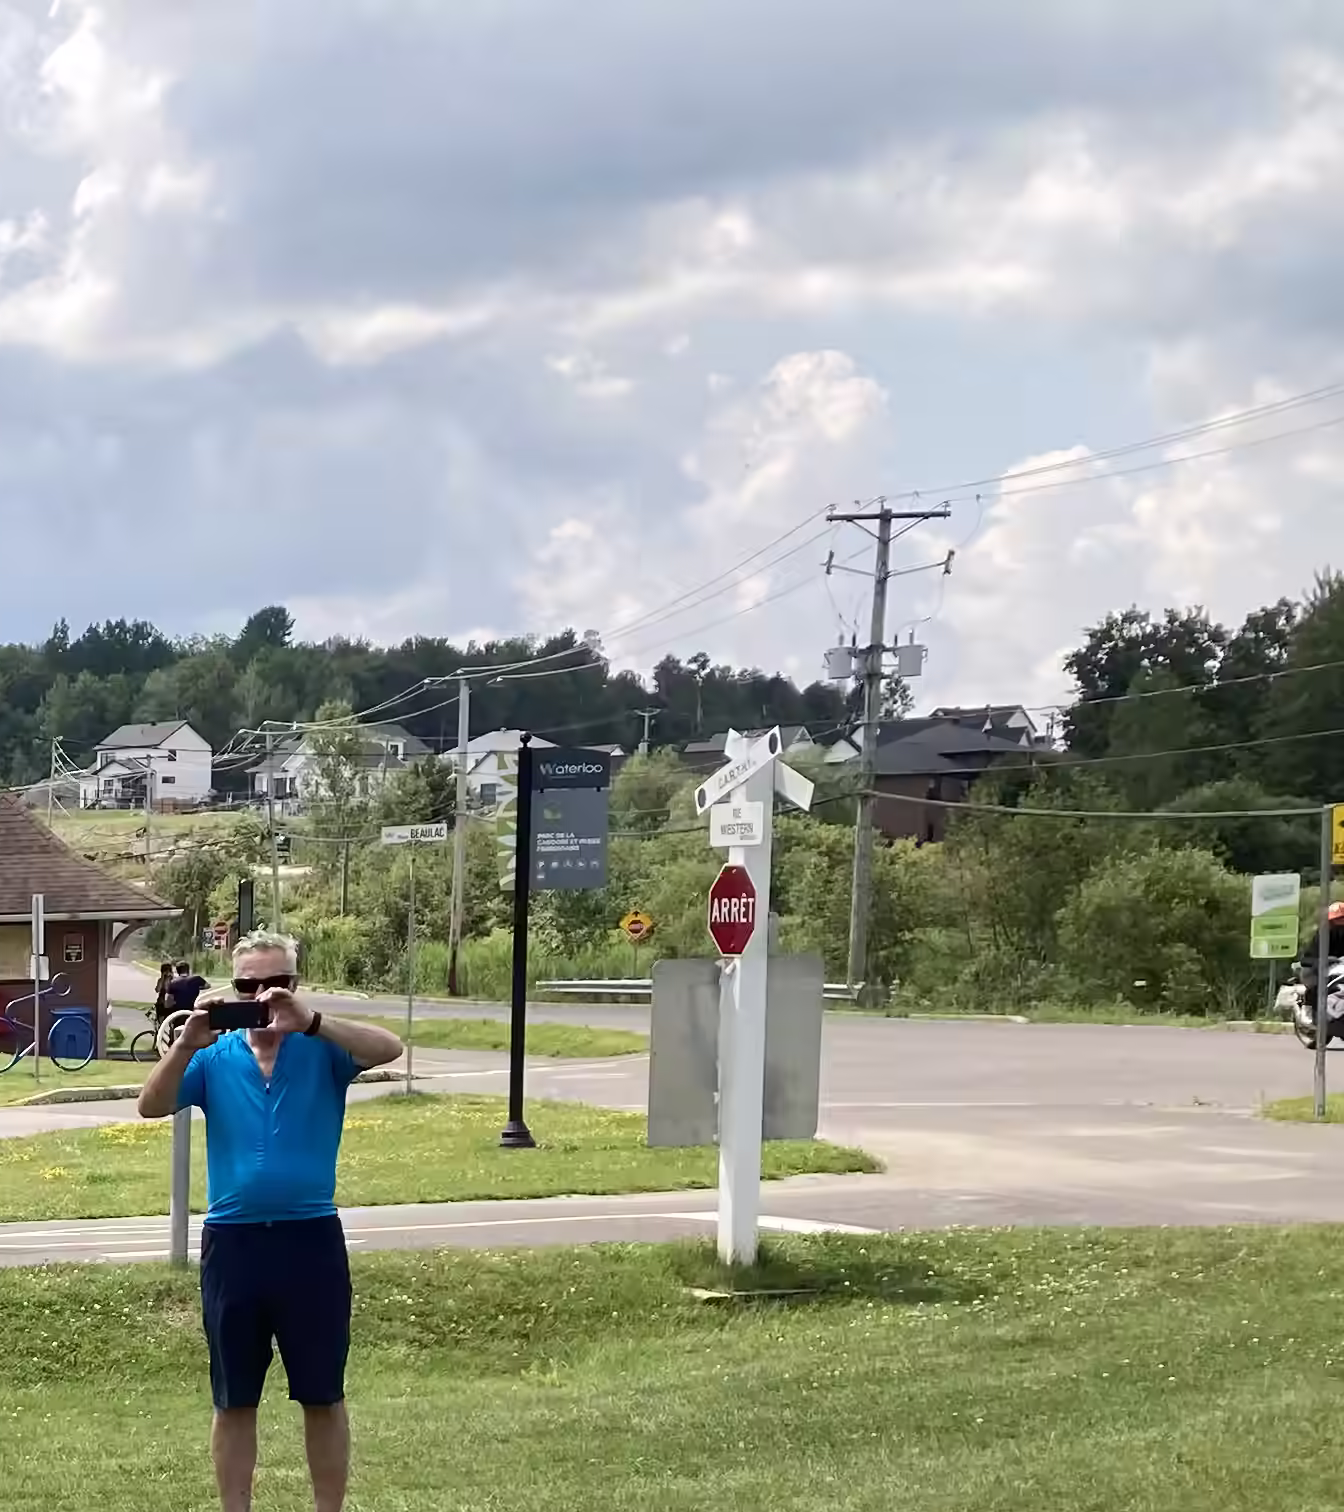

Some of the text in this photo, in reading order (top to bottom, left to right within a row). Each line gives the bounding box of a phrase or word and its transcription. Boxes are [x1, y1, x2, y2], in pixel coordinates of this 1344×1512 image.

[540, 762, 602, 775] Waterloo
[411, 827, 444, 838] BEAULAC
[711, 892, 755, 923] ARRÊT
